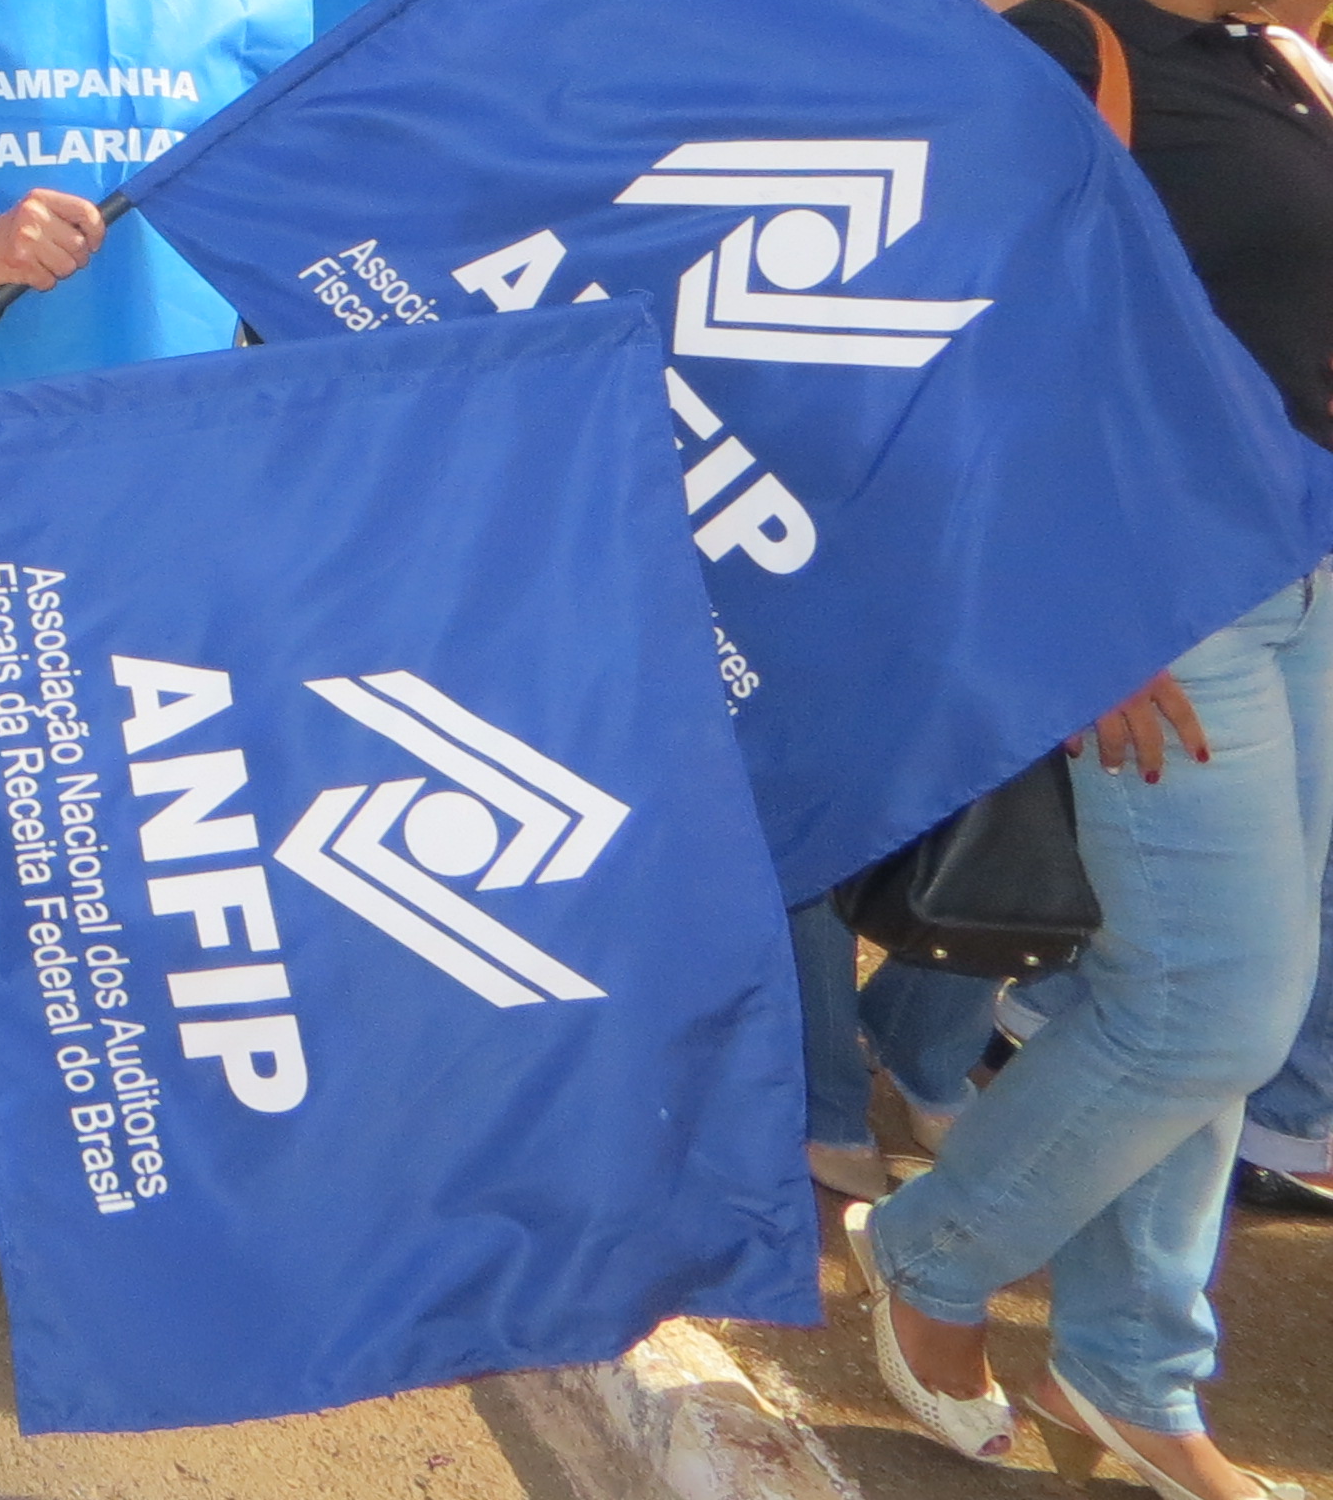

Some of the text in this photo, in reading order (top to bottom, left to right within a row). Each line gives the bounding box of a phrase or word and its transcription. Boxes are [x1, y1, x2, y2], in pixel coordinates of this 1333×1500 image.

[0, 746, 52, 887] Receita
[23, 564, 169, 1199] Associação Nacional dos Auditores
[110, 654, 308, 1114] ANFIP
[23, 894, 78, 1037] Federal
[56, 1042, 96, 1094] do
[69, 1102, 136, 1216] Brasil
